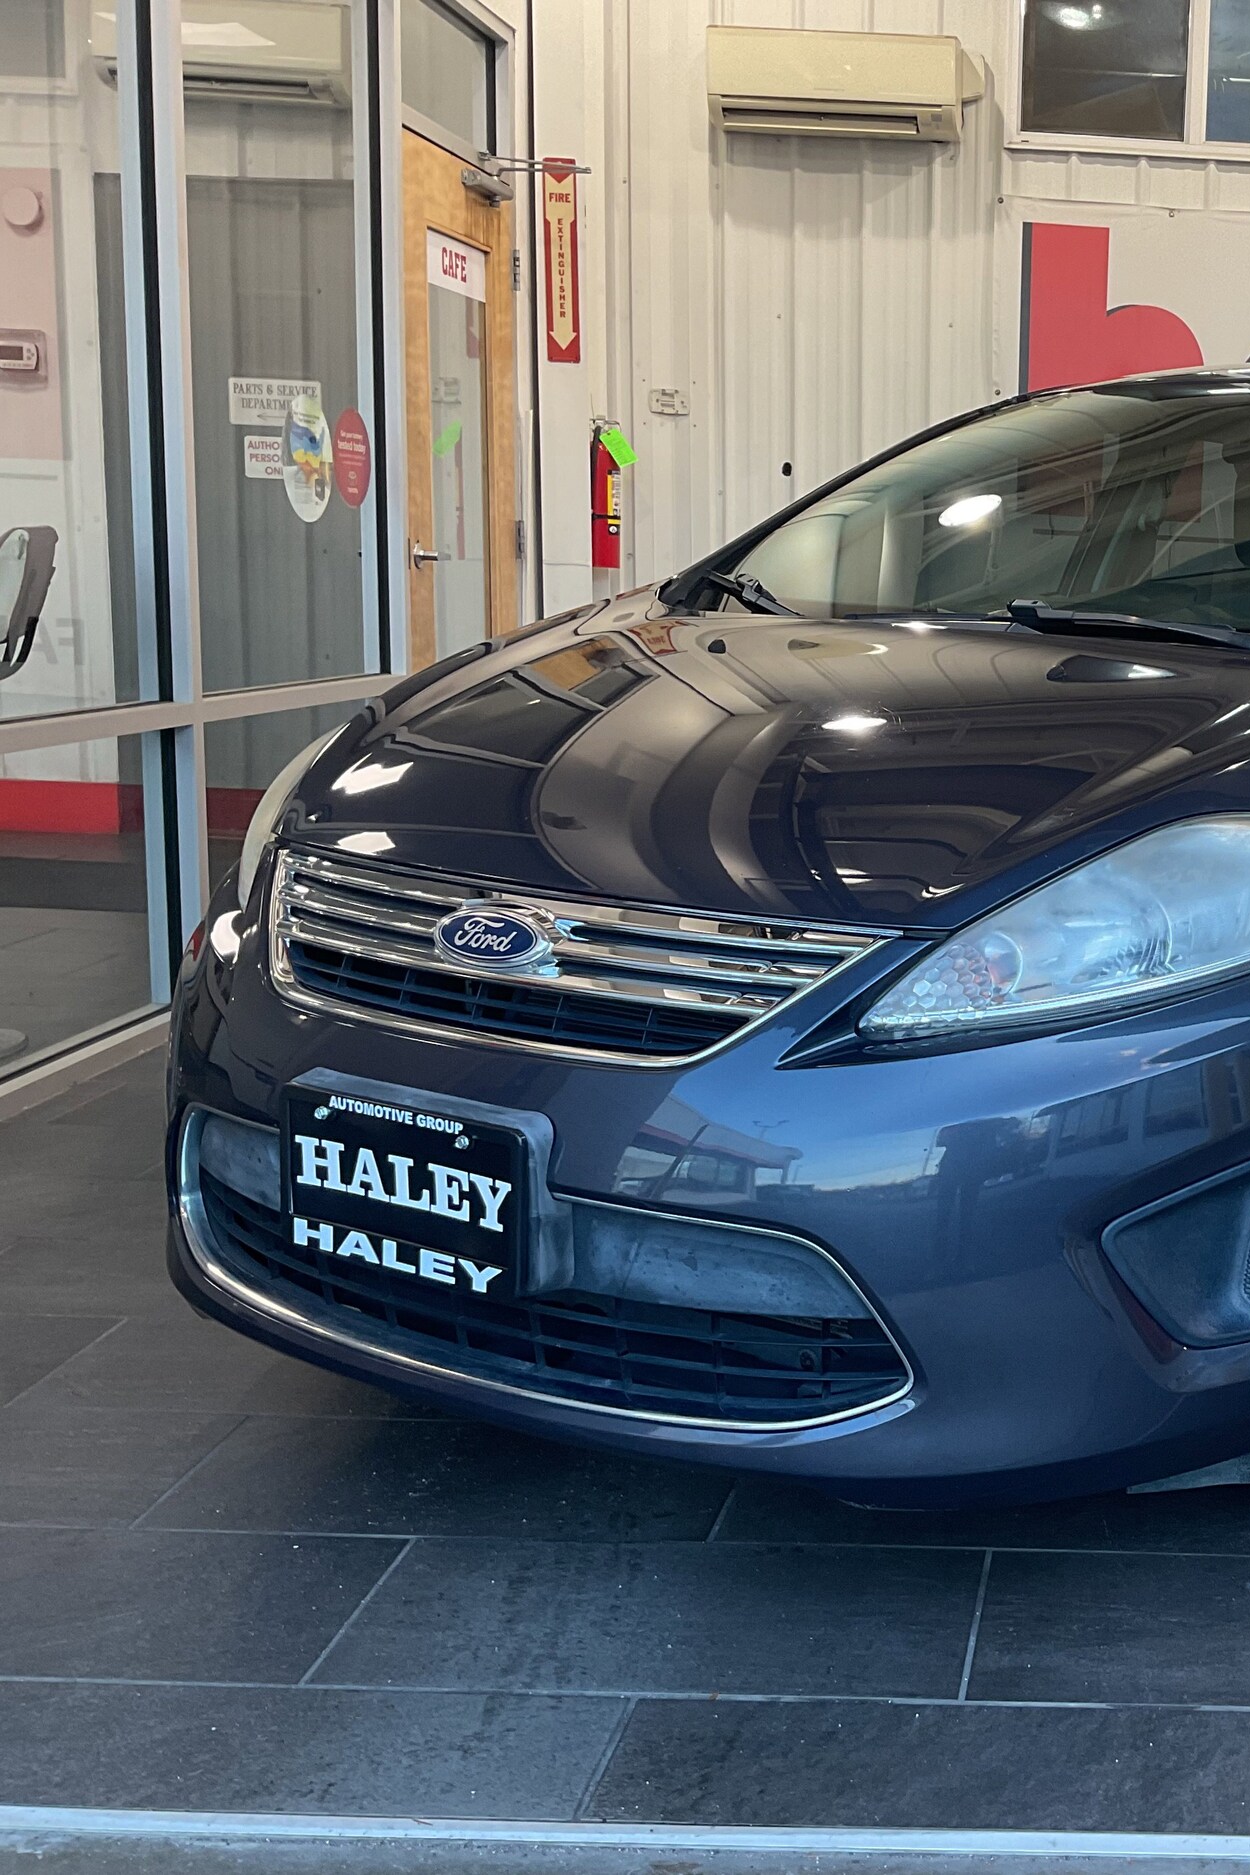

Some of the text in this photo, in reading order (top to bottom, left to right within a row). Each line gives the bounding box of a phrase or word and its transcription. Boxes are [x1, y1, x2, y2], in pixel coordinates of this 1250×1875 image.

[549, 193, 571, 203] FIRE
[441, 246, 467, 283] CAFE
[557, 218, 566, 318] EXTINGUISHER
[233, 382, 317, 398] PARTS & SERVICE
[241, 397, 292, 410] DEPARTME
[247, 440, 280, 450] AUTHO
[250, 453, 279, 463] PERSO
[454, 917, 517, 953] Ford
[329, 1095, 464, 1135] AUTOMOTIVE GROUP
[295, 1135, 512, 1233] HALEY
[293, 1217, 503, 1293] HALEY
